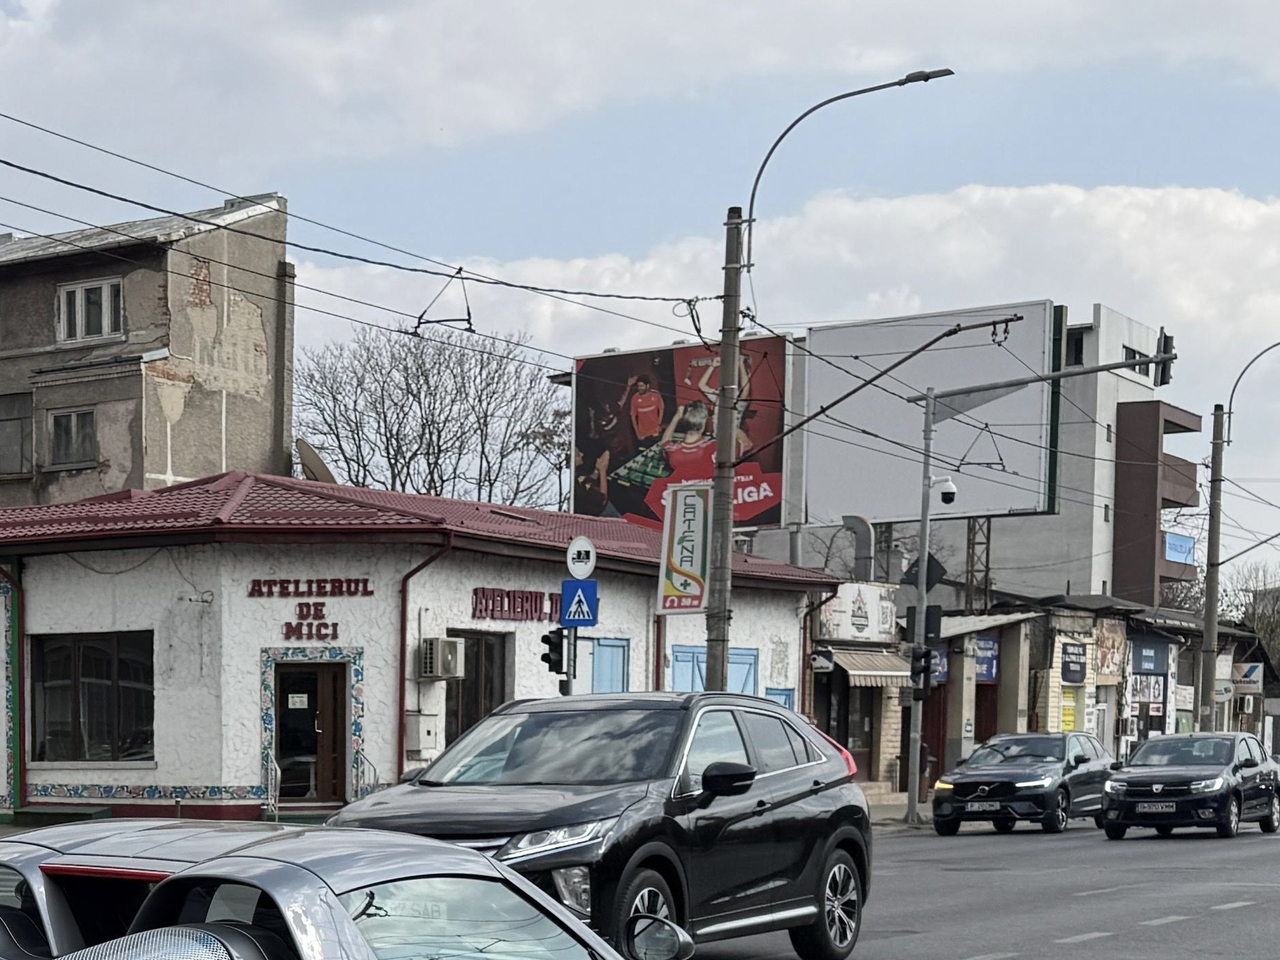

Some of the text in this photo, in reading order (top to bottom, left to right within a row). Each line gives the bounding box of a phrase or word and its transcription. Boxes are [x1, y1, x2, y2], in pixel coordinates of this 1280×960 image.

[679, 494, 696, 568] CATENA
[248, 578, 374, 598] ATELIERUL
[297, 602, 326, 620] DE
[472, 587, 562, 624] ATELIERUL D
[284, 622, 339, 641] MICI
